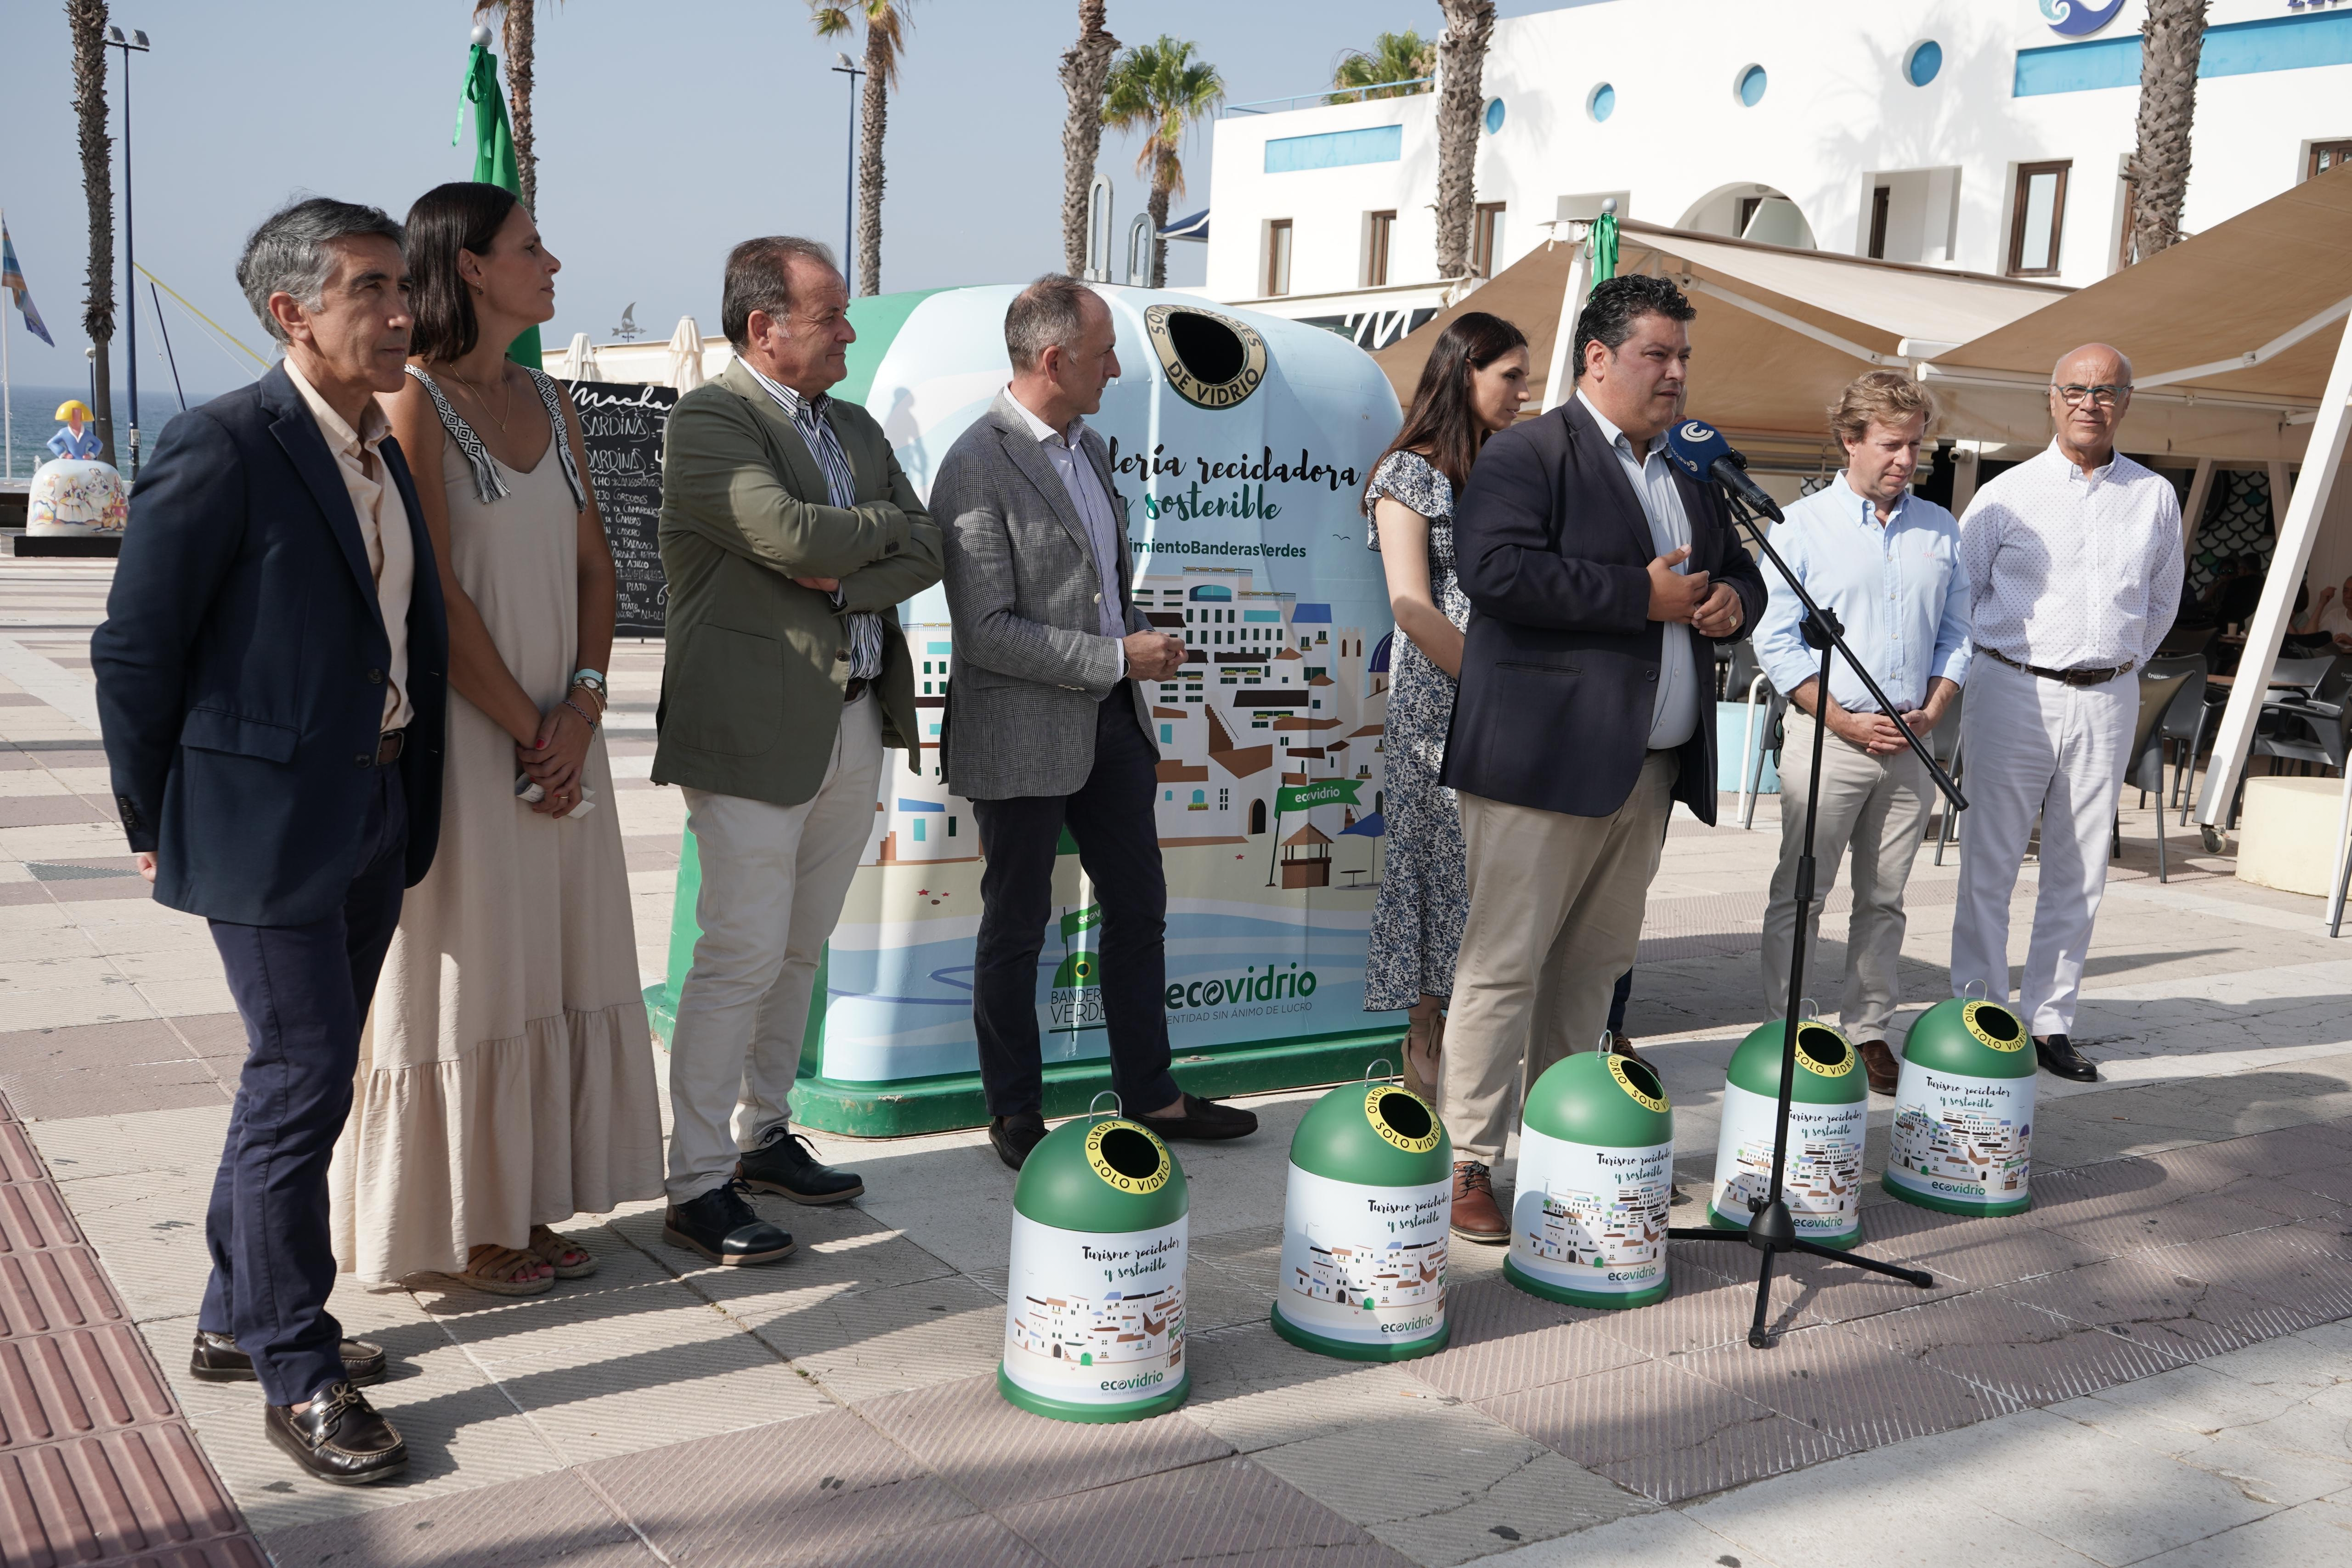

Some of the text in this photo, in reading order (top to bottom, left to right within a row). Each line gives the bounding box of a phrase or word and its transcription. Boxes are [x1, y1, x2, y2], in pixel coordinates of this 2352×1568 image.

[1167, 361, 1259, 405] DE VIDRIO
[1109, 436, 1361, 491] lería recicladora
[1145, 481, 1282, 521] sostenible
[1130, 537, 1306, 558] imientoBanderasVerdes
[1295, 786, 1340, 803] ecovidrio
[1165, 962, 1317, 1010] ecovidrio
[1051, 988, 1102, 1005] BANDER
[1166, 1002, 1312, 1025] ENTIDAD SIN ÁNIMO DE LUCRO
[1973, 1028, 2026, 1050] SOLO VIDRIO
[1795, 1051, 1854, 1075] SOLO VIDRIO
[1926, 1076, 1962, 1091] Turismo
[1367, 1087, 1392, 1114] VIDRIO
[1632, 1090, 1660, 1110] SOLO
[1940, 1096, 1946, 1107] y
[1789, 1109, 1824, 1122] urismo
[1088, 1122, 1121, 1150] VIDRIO
[1376, 1121, 1440, 1150] SOLO VIDRIO
[1802, 1128, 1809, 1139] y
[1596, 1153, 1637, 1167] Turismo
[1094, 1160, 1169, 1191] SOLO VIDRIO
[1615, 1173, 1623, 1184] y
[1932, 1181, 1986, 1195] ecovidrio
[1368, 1199, 1412, 1214] Turismo
[1388, 1221, 1397, 1233] y
[1793, 1216, 1843, 1228] ecovidrio
[1082, 1246, 1132, 1261] Turismo
[1104, 1269, 1115, 1282] y
[1608, 1265, 1656, 1280] ecovidrio
[1381, 1314, 1433, 1332] ecovidrio
[1101, 1370, 1163, 1390] ecovidrio
